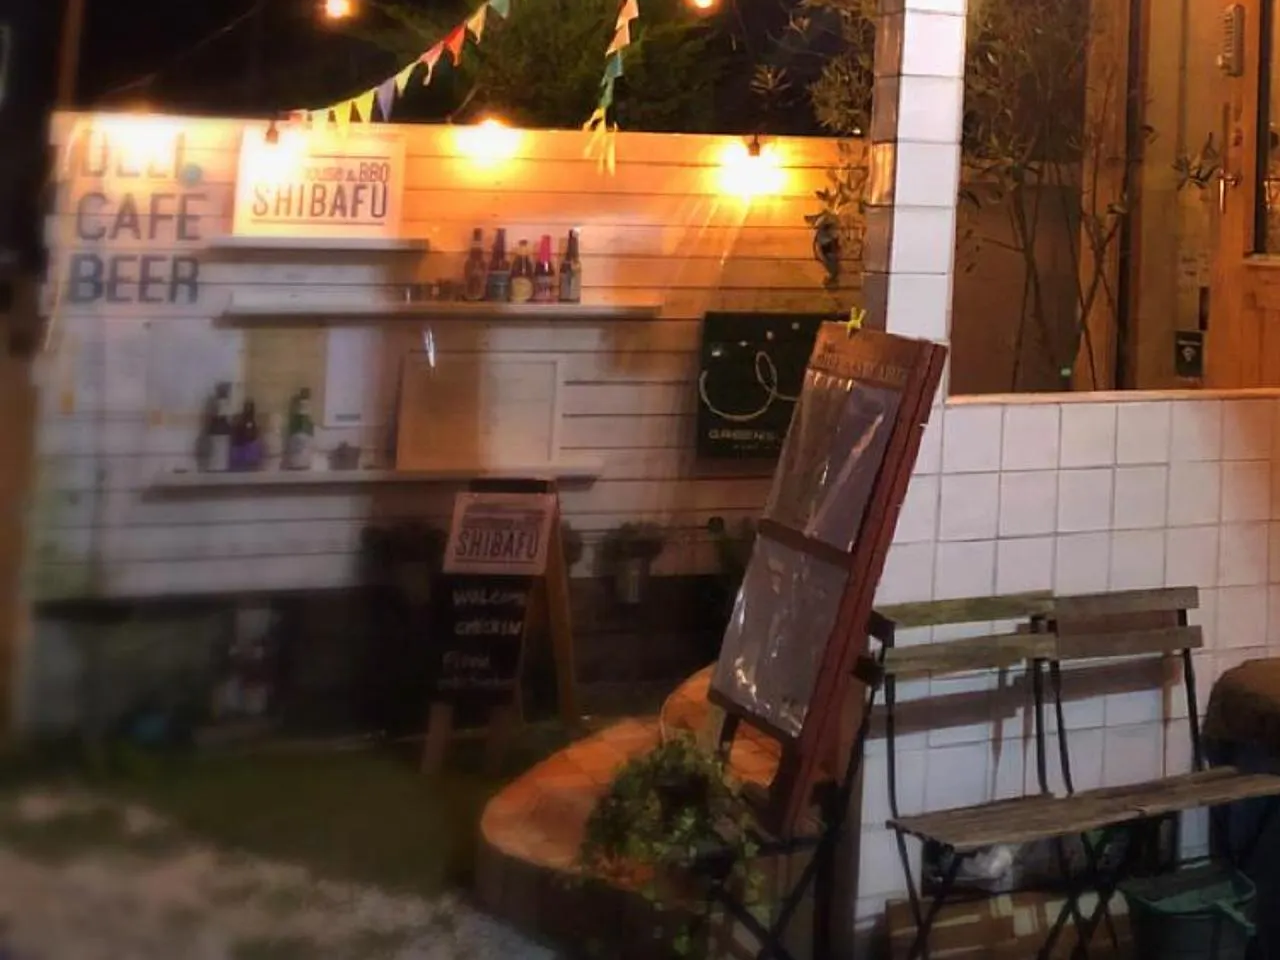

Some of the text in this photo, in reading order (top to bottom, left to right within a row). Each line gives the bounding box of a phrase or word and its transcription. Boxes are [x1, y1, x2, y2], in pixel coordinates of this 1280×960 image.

[76, 192, 208, 242] CAFE
[252, 183, 388, 218] SHIBAFU
[67, 253, 200, 304] BEER
[456, 527, 539, 559] SHIBAFU
